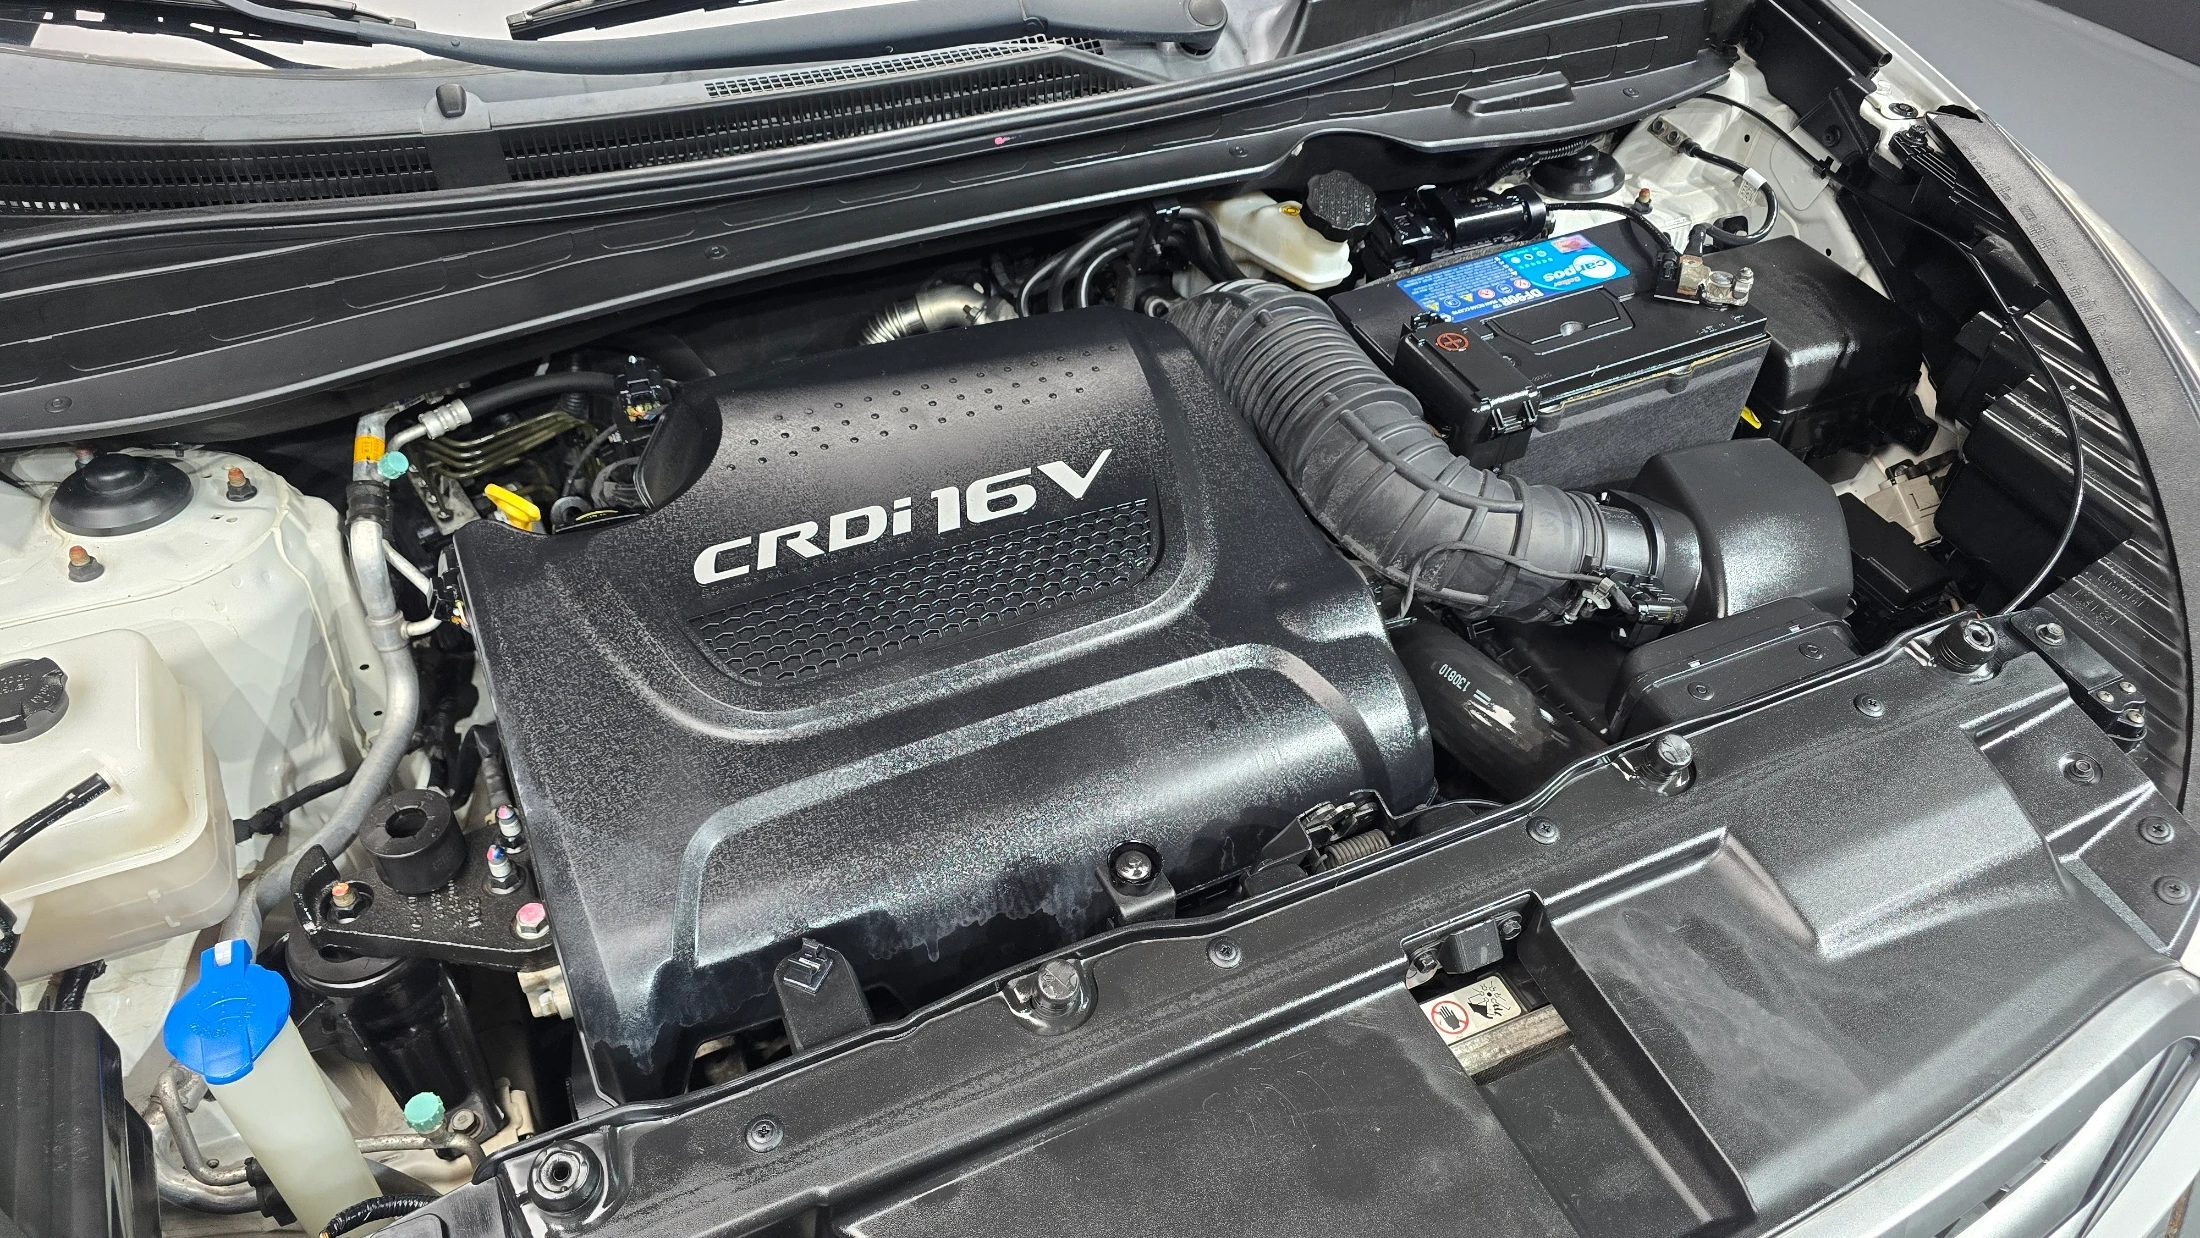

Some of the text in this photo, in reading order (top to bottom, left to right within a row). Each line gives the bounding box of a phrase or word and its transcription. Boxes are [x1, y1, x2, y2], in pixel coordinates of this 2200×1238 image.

[1502, 288, 1544, 307] DF90R
[693, 497, 912, 587] CRDi
[931, 449, 1112, 534] 16V
[1438, 663, 1471, 693] 130810
